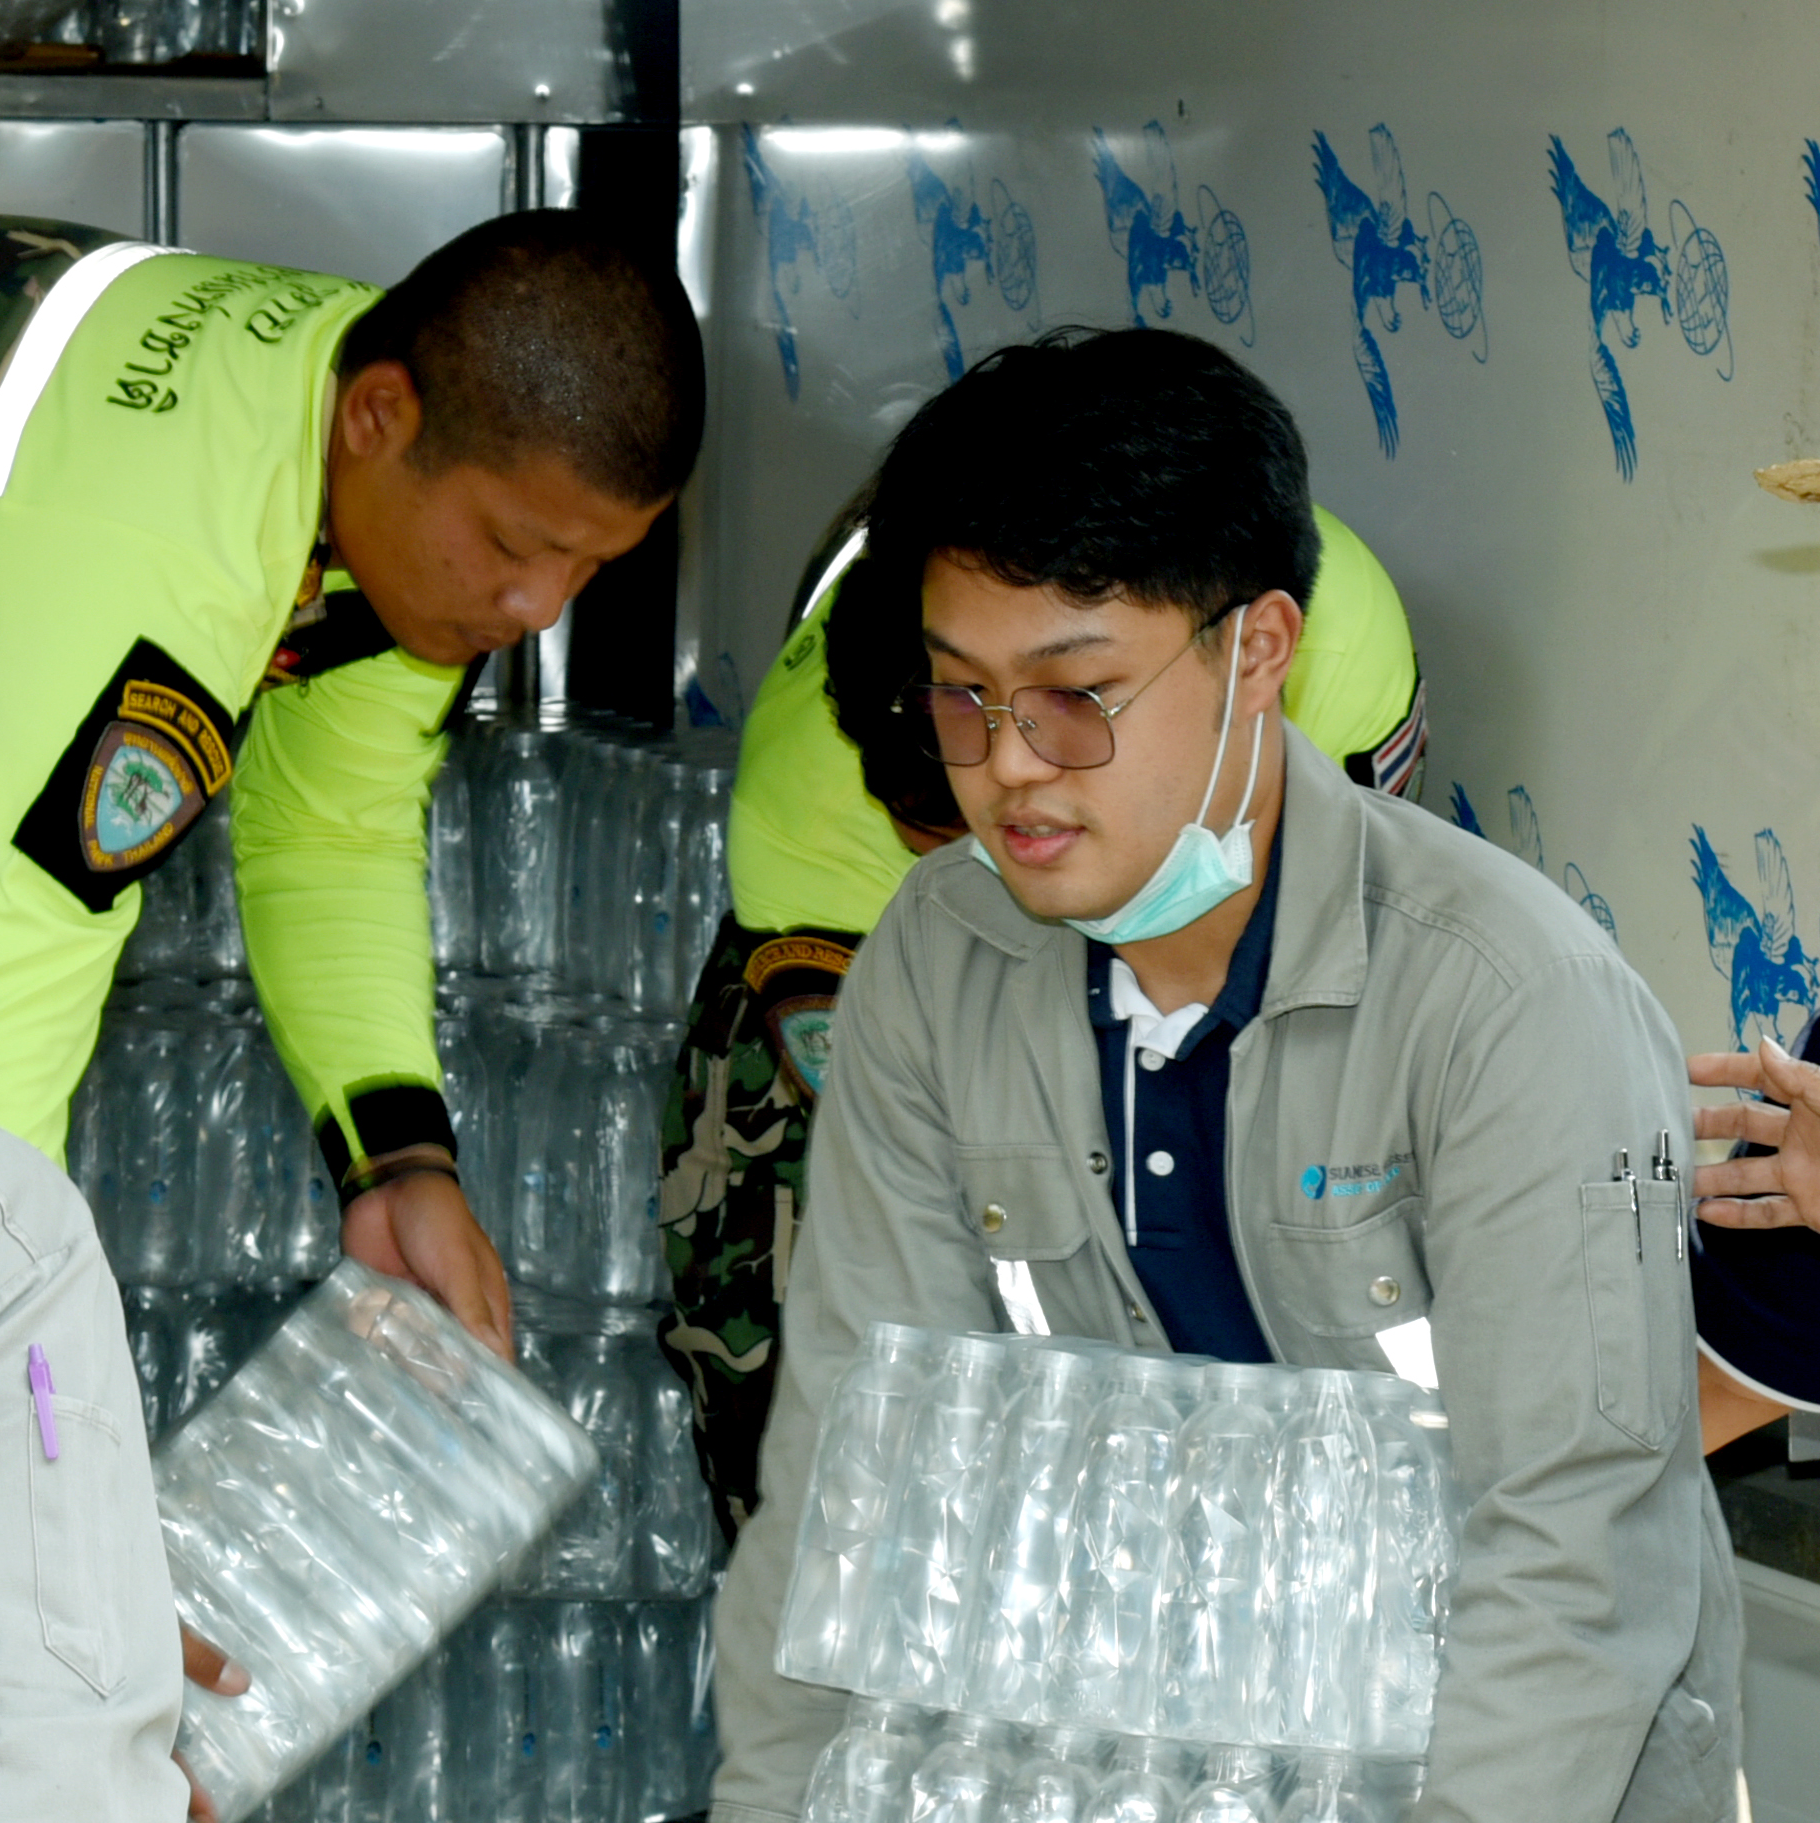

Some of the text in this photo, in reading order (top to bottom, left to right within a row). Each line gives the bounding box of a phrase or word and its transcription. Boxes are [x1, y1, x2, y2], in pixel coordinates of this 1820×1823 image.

[129, 692, 178, 720] SEARCH
[178, 709, 201, 736] AND
[122, 820, 176, 865] THAILAND
